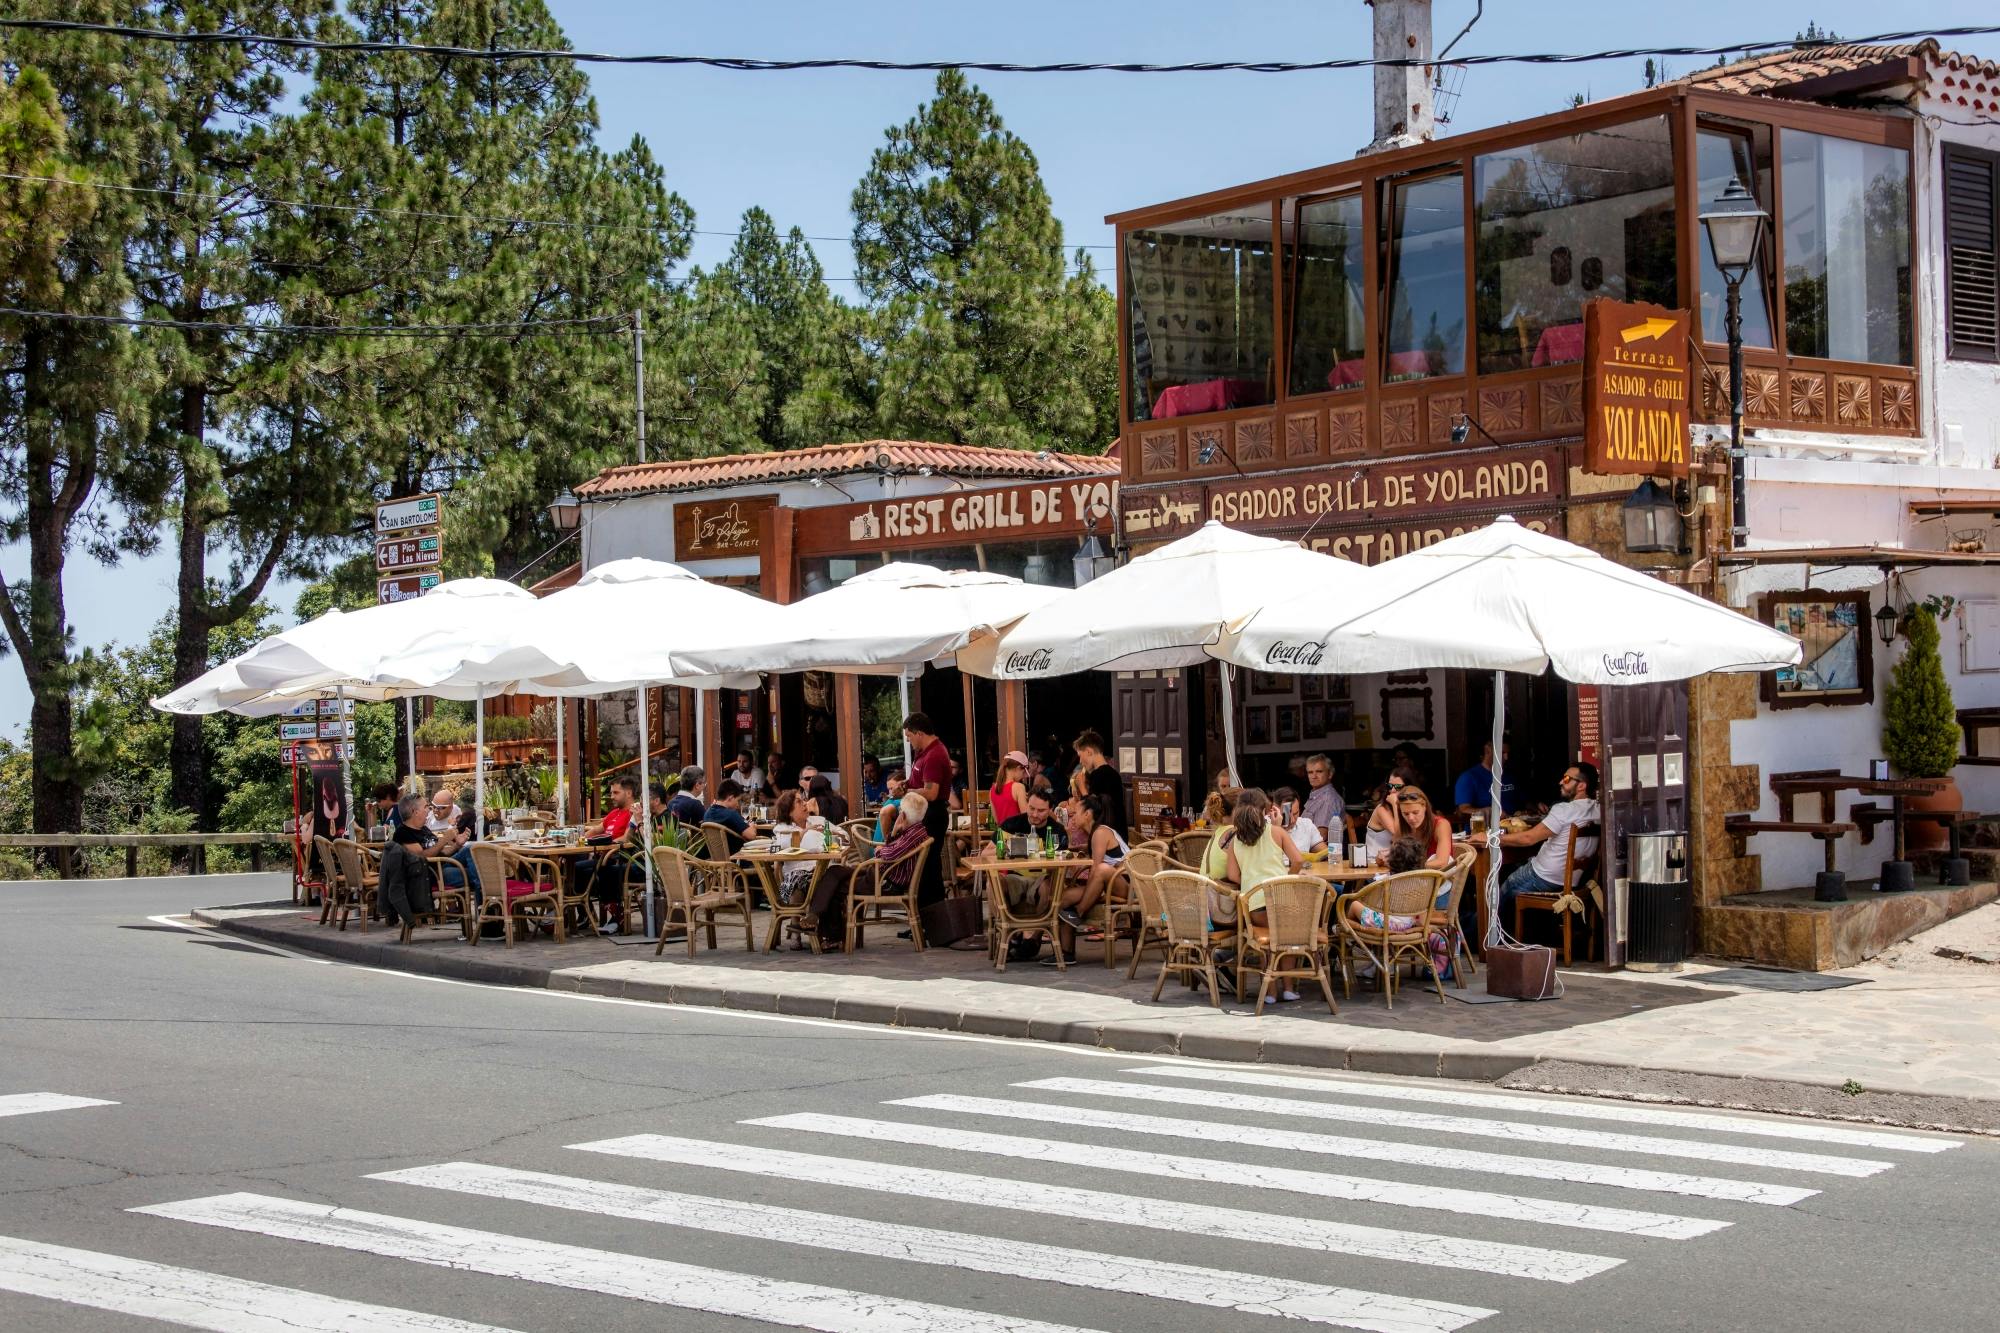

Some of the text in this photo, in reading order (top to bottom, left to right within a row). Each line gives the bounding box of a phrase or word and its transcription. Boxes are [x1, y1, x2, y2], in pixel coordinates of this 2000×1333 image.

[1613, 346, 1674, 366] Terraza
[1603, 374, 1684, 400] ASADOR GRILL
[1603, 406, 1684, 464] YOLANDA
[1211, 459, 1549, 522] ASADOR GRILL DE YOLANDA
[885, 499, 946, 538] REST.
[951, 491, 1024, 531] GRILL
[1031, 487, 1062, 524] DE
[386, 518, 399, 528] SAN
[701, 522, 715, 538] El
[402, 543, 416, 553] Pico
[402, 551, 438, 563] Las Nieves
